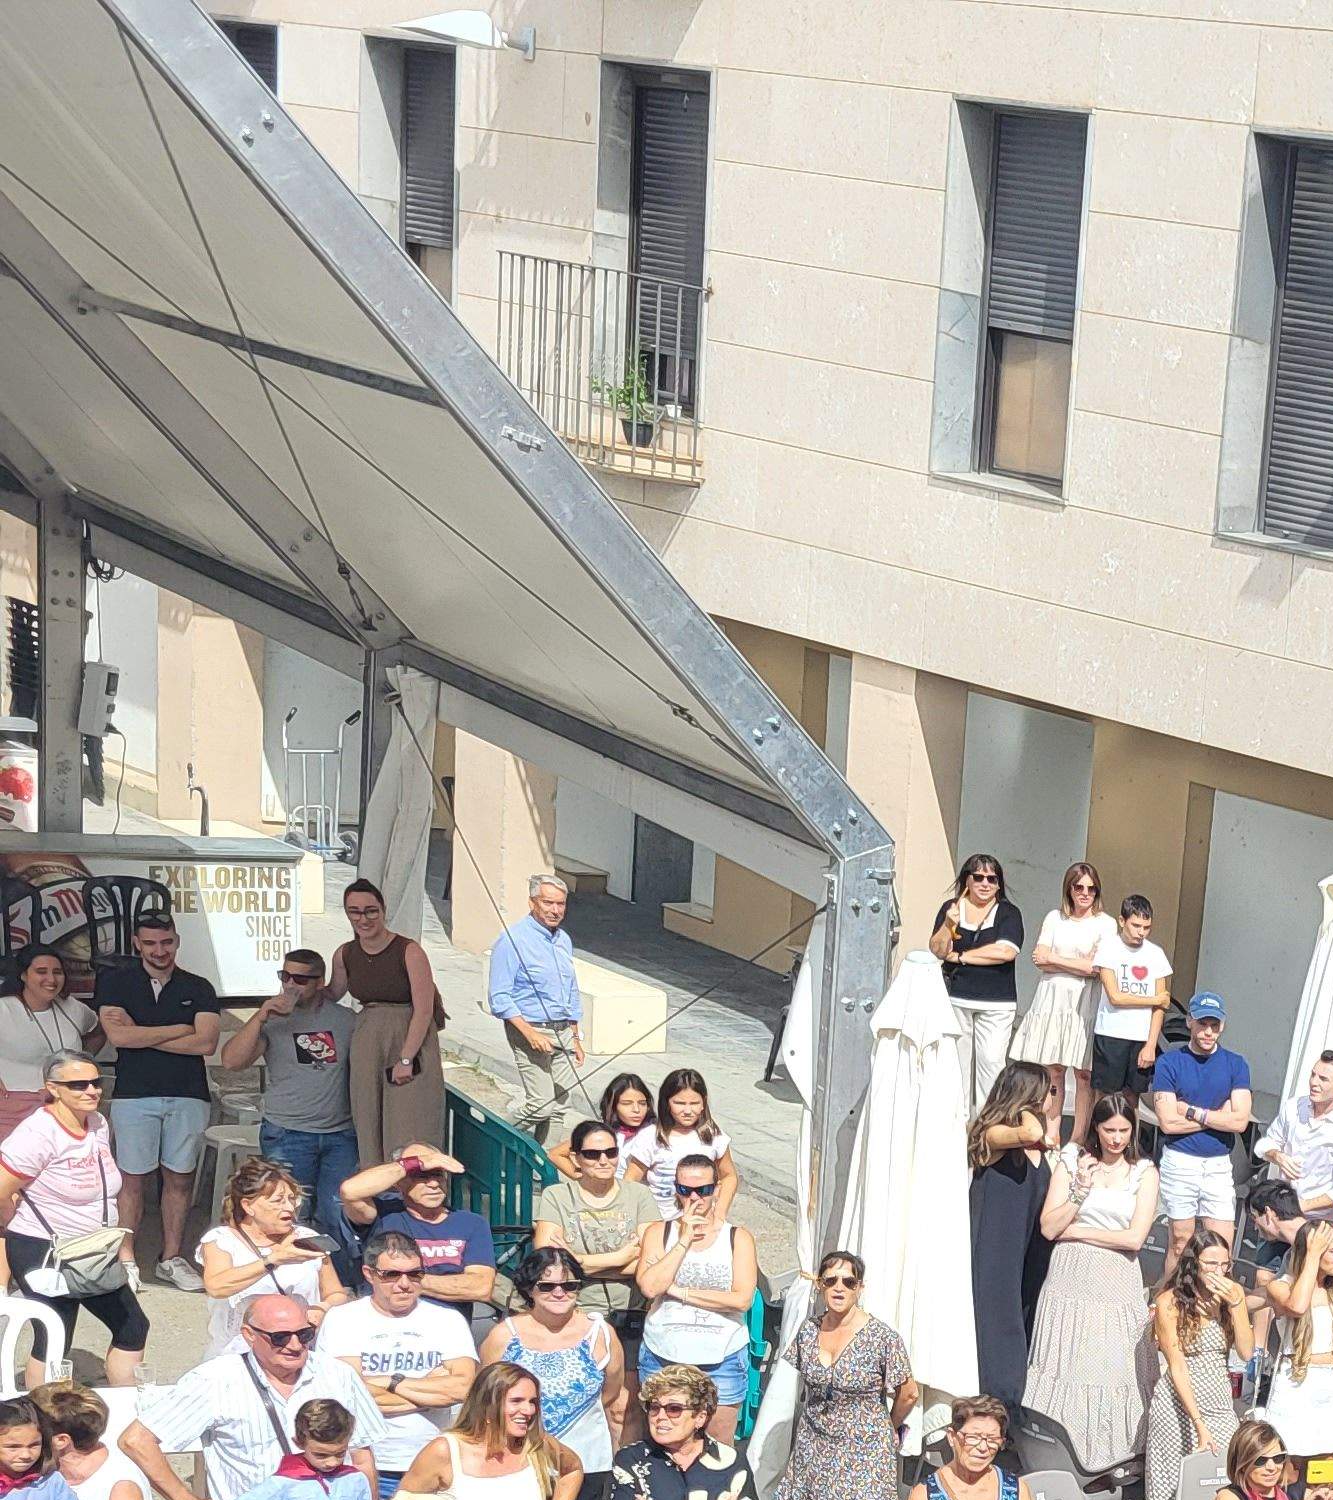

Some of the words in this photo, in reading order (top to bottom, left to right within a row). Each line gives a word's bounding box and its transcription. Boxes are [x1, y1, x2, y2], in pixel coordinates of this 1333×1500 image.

[149, 865, 292, 890] EXPLORING
[204, 890, 292, 914] WORLD
[245, 915, 292, 938] SINCE
[1120, 981, 1149, 996] BCN
